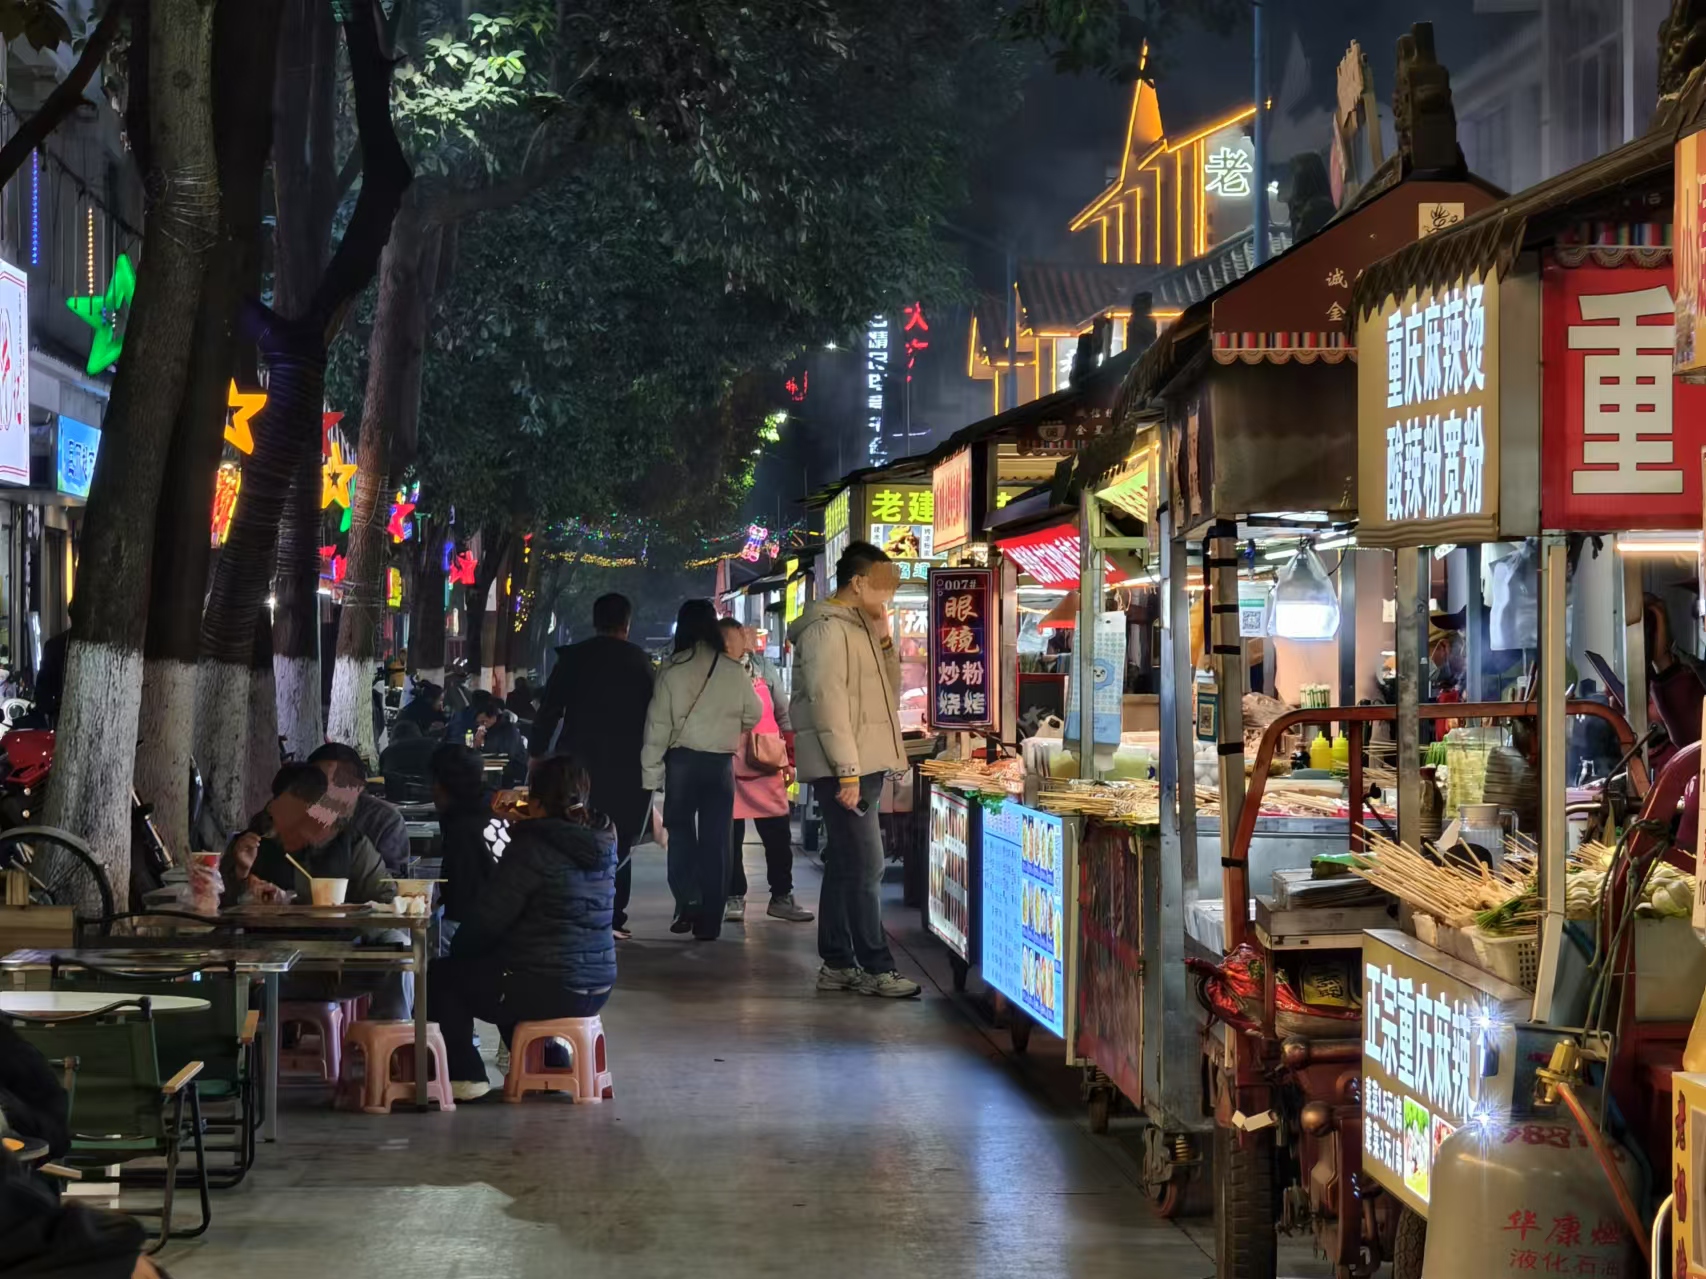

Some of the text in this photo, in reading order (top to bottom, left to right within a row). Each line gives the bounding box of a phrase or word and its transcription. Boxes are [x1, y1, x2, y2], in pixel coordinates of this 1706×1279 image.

[1386, 282, 1485, 409] 重庆麻辣烫
[1567, 286, 1684, 495] 重
[1386, 405, 1485, 522] 酸辣粉宽粉
[942, 594, 980, 654] 眼镜
[944, 579, 977, 591] 007#
[938, 660, 985, 686] 炒粉
[938, 689, 985, 716] 烧烤
[1364, 962, 1486, 1124] 正宗重庆麻辣
